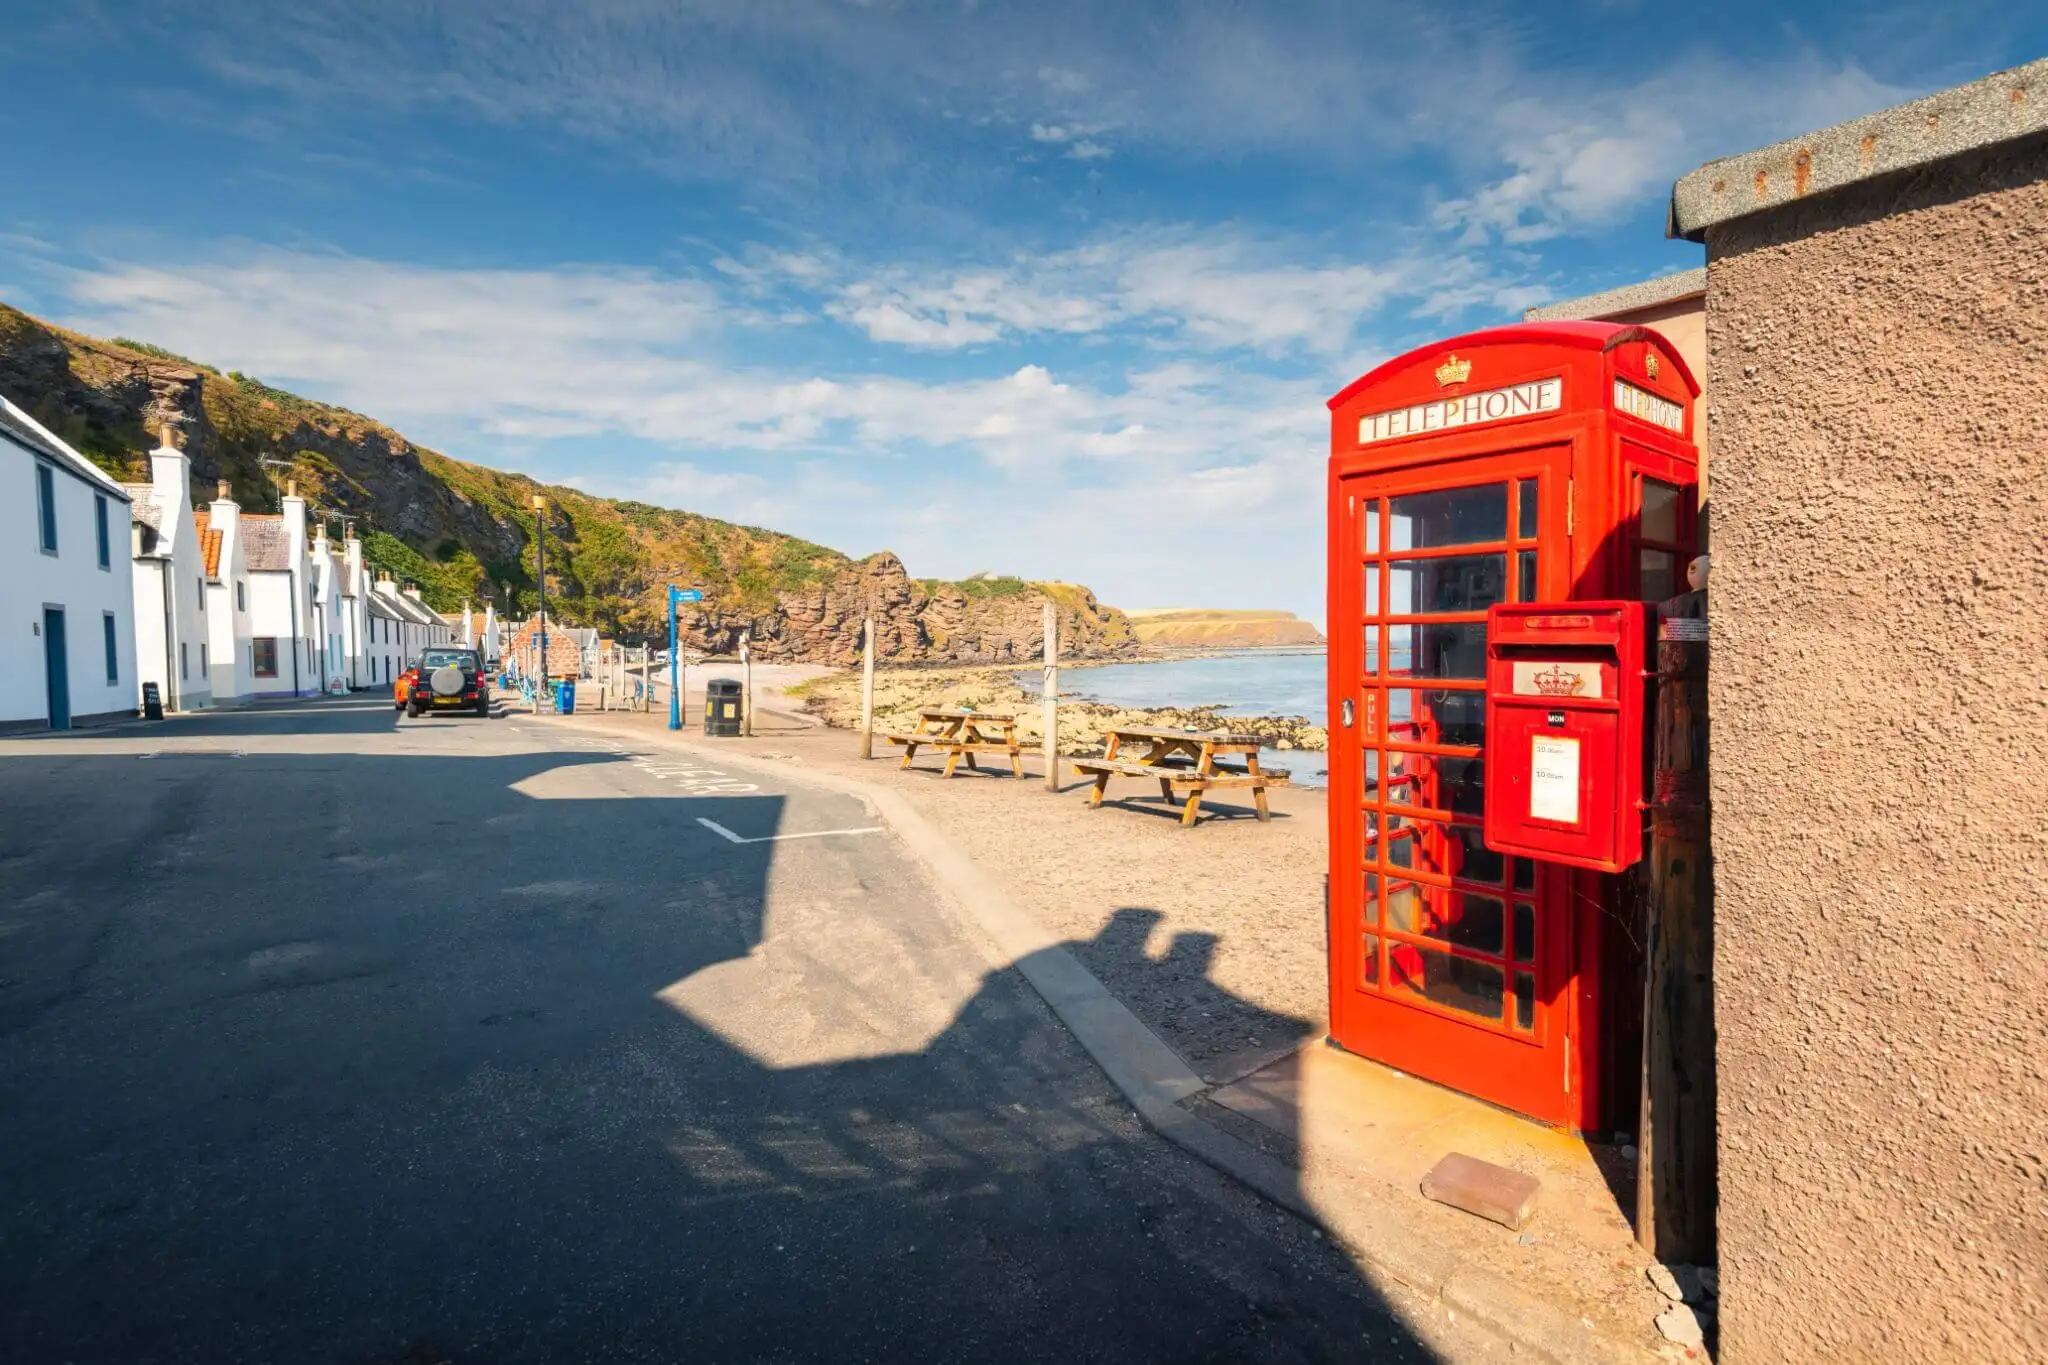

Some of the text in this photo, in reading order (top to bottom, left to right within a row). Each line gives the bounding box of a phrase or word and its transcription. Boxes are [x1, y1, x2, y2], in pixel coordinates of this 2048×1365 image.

[1368, 382, 1553, 438] TELEPHONE
[1614, 383, 1681, 430] TELEPHONE
[1367, 694, 1375, 734] PULL
[1547, 713, 1565, 723] MON
